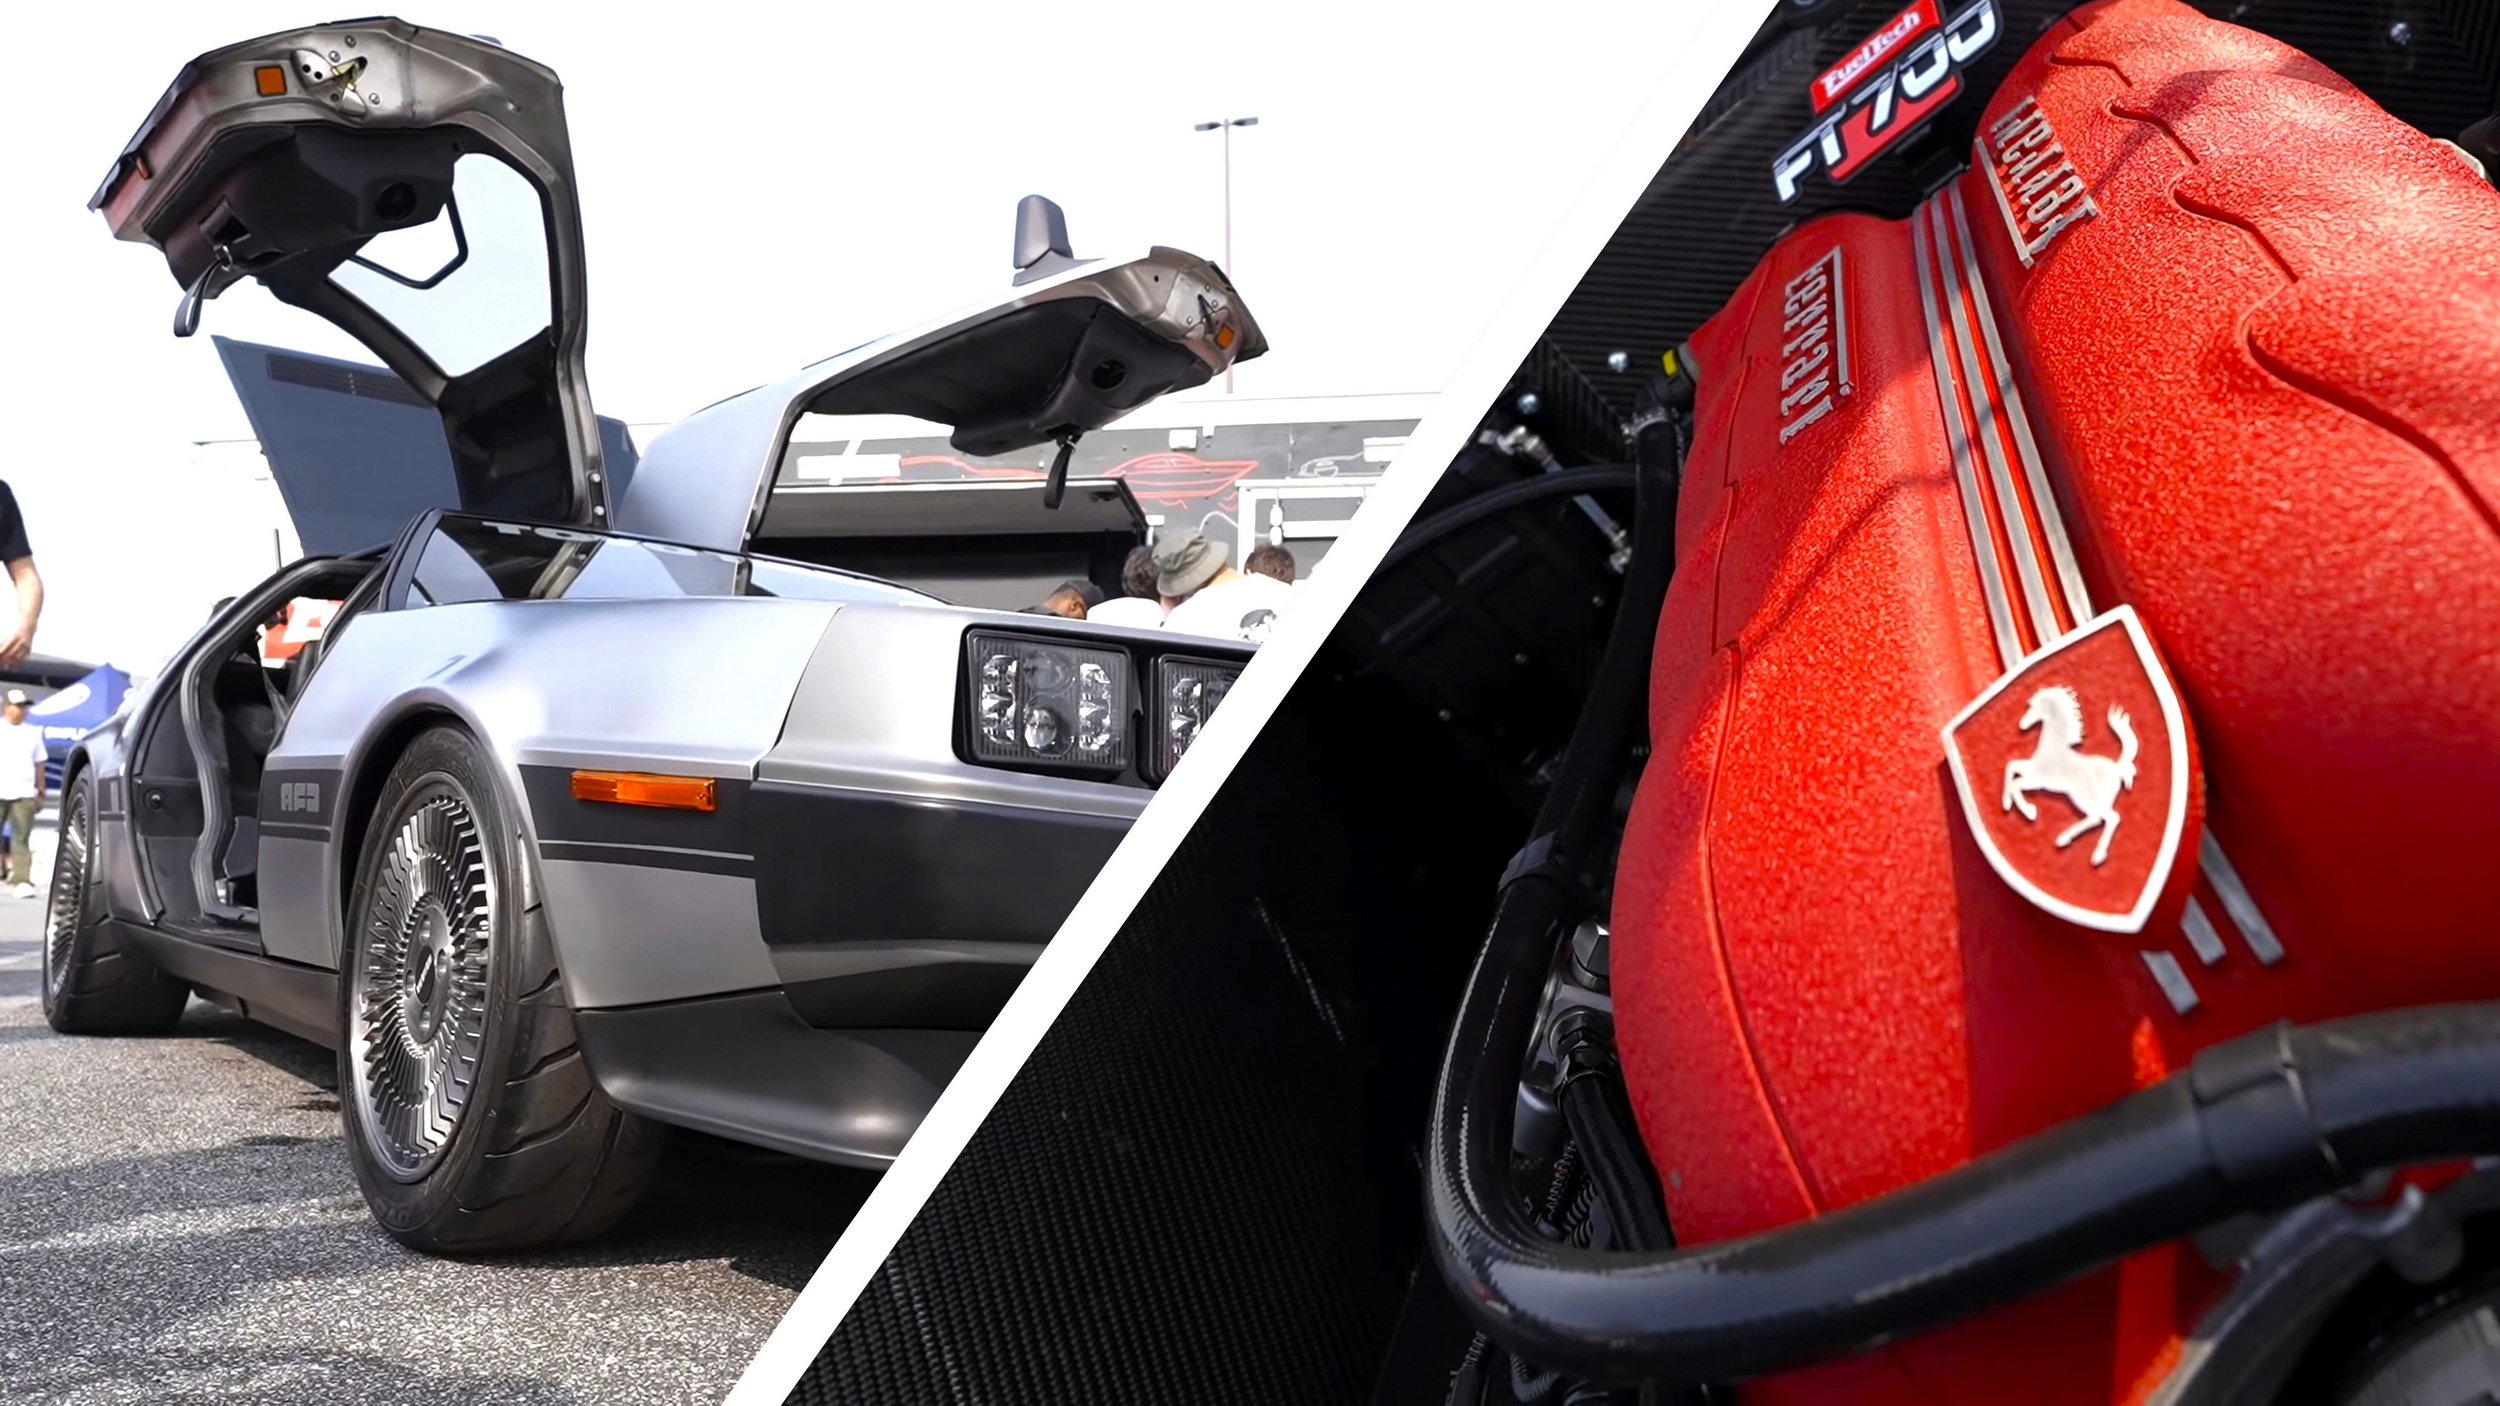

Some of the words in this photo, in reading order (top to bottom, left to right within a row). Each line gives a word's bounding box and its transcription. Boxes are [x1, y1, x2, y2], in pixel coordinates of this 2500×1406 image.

[1772, 0, 1997, 201] FT700
[1820, 11, 1921, 98] FuelTech
[1974, 94, 2099, 270] Ferrari
[1779, 245, 1855, 445] Ferrari
